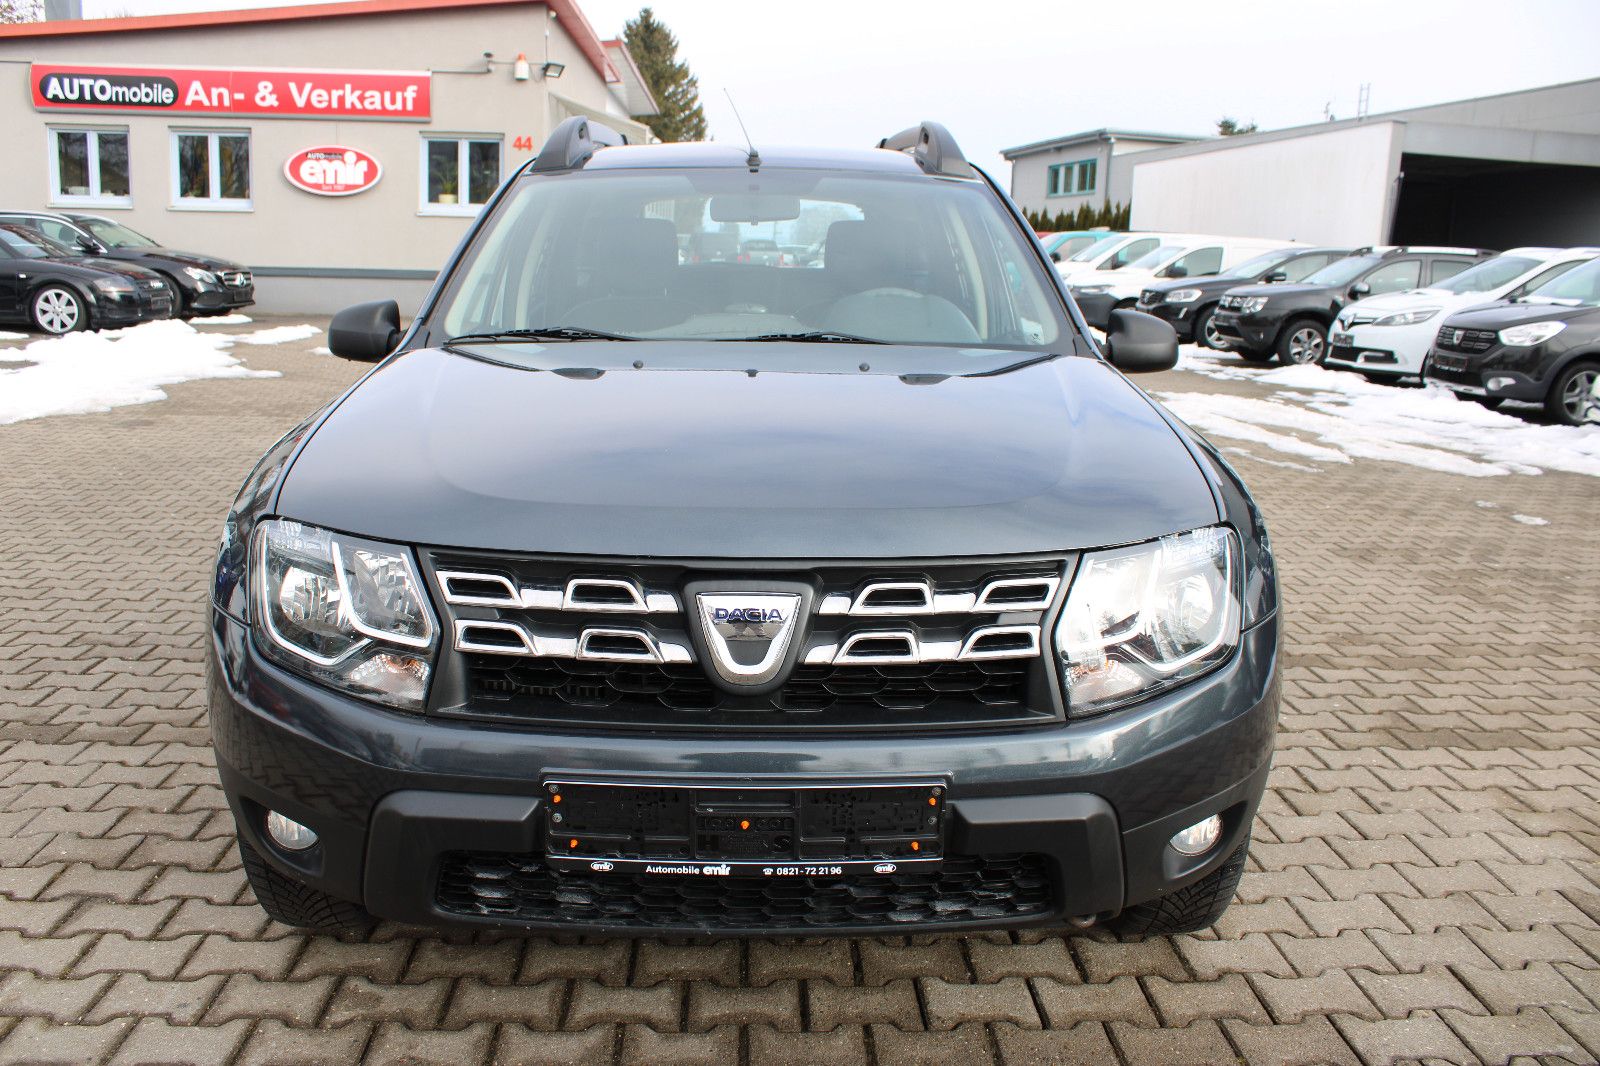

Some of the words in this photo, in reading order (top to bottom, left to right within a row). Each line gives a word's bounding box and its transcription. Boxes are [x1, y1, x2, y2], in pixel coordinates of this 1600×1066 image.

[45, 76, 175, 104] AUTOmobile
[184, 80, 245, 107] An-
[254, 80, 279, 107] &
[288, 82, 418, 111] Verkauf
[512, 135, 533, 151] 44
[299, 151, 368, 185] emir
[715, 607, 783, 621] DACIA
[645, 865, 700, 875] Automobile
[702, 863, 731, 876] emir
